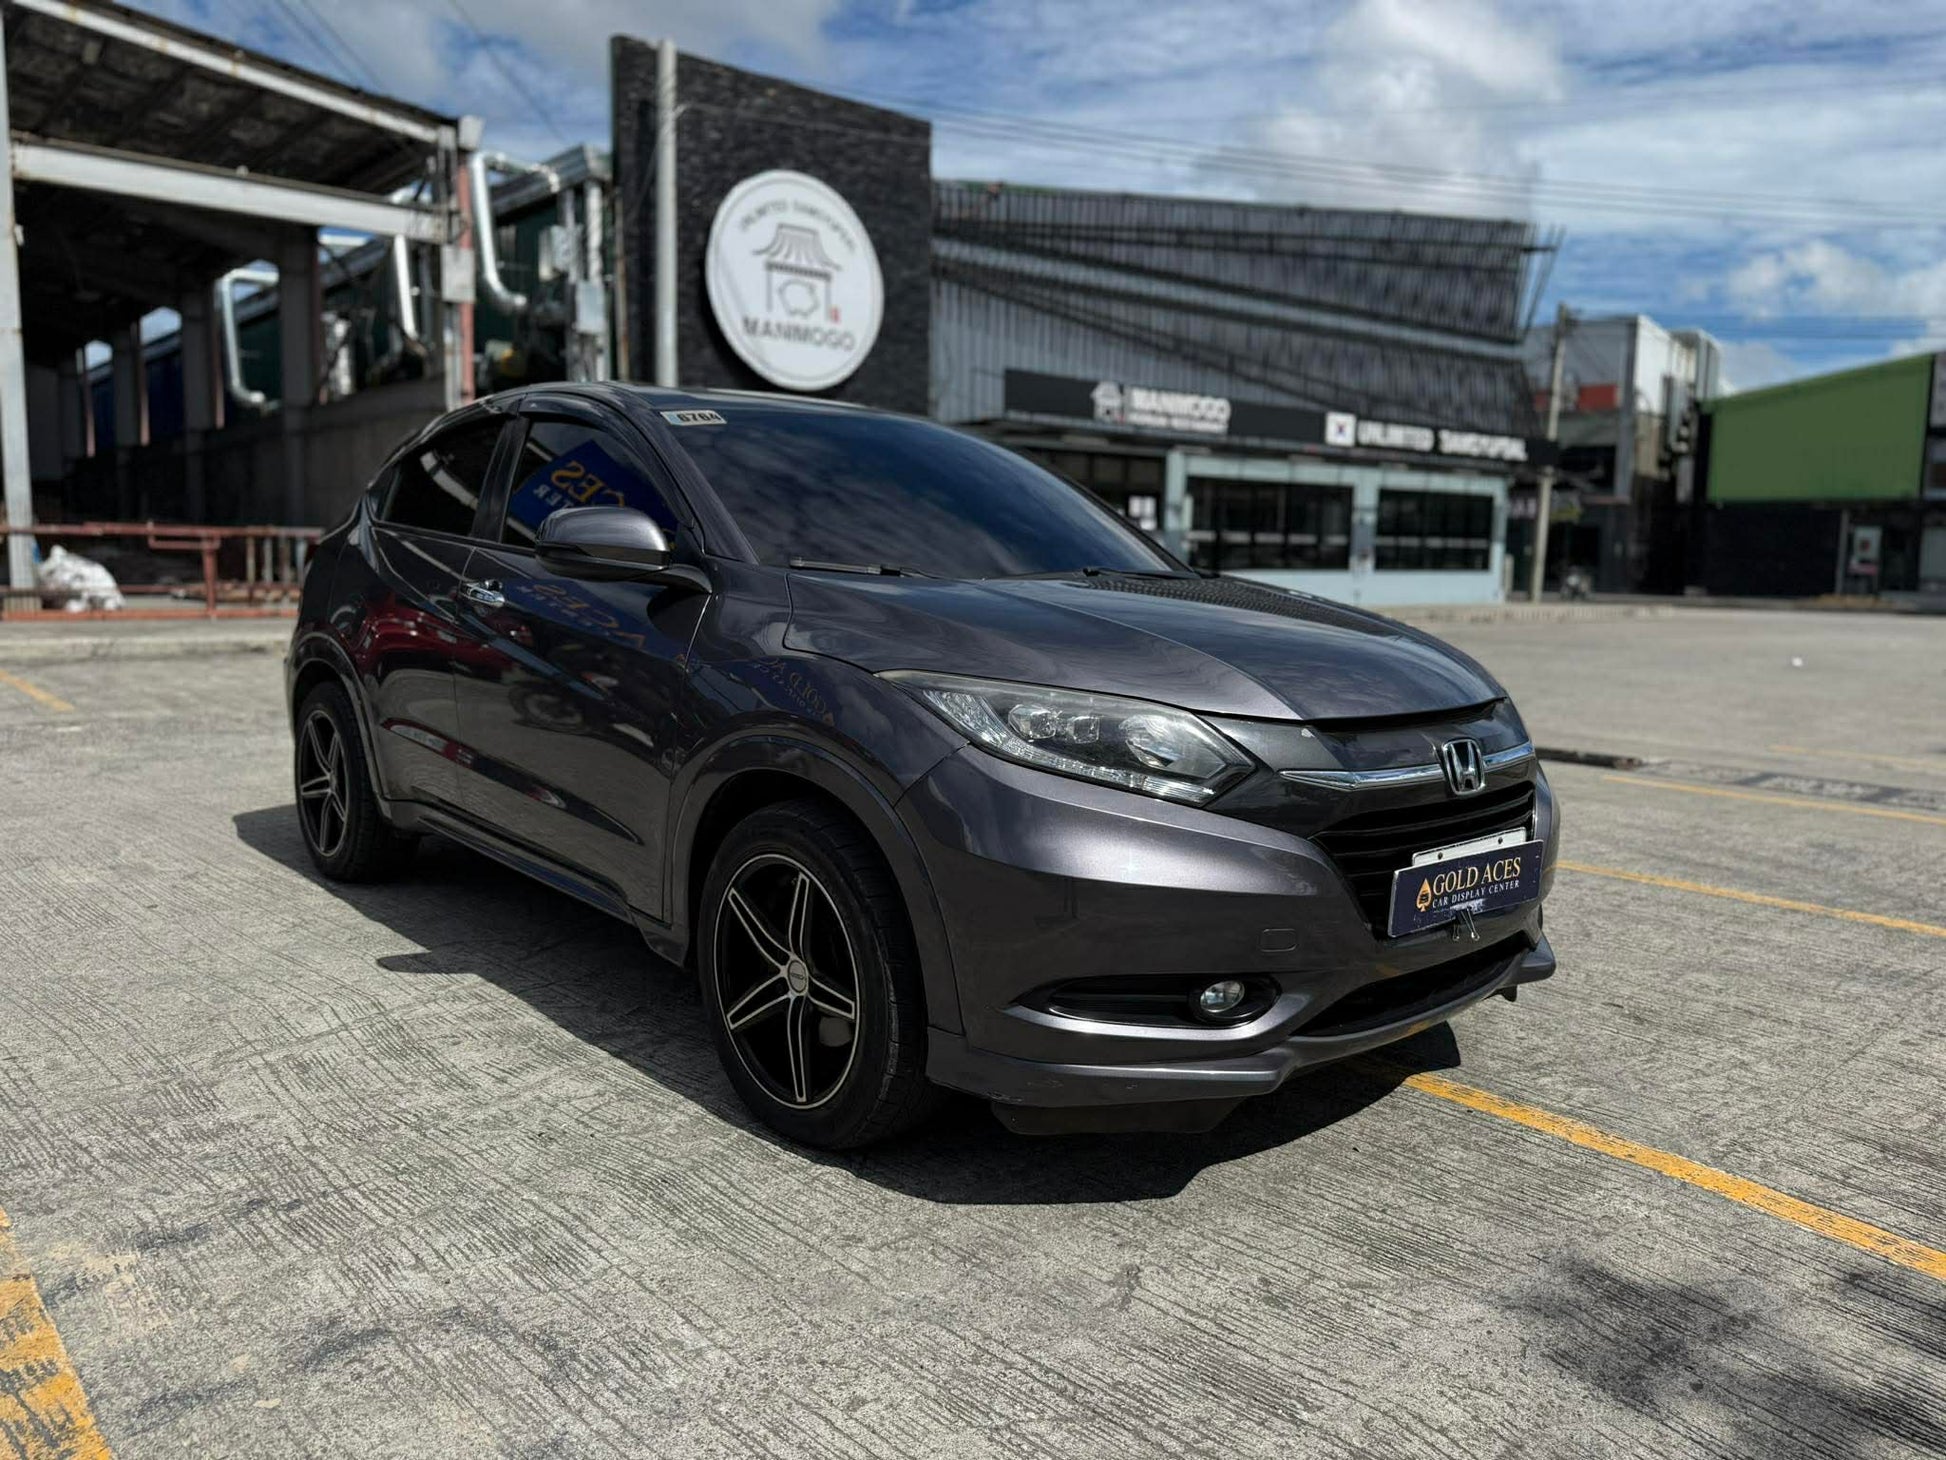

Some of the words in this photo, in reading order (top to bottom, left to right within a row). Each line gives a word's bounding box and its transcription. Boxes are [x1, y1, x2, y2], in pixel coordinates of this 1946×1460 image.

[1432, 866, 1479, 896] GOLD
[1481, 857, 1522, 884] ACES
[1432, 895, 1449, 908] CAR
[1451, 887, 1486, 904] DISPLAY
[1488, 880, 1520, 895] CENTER
